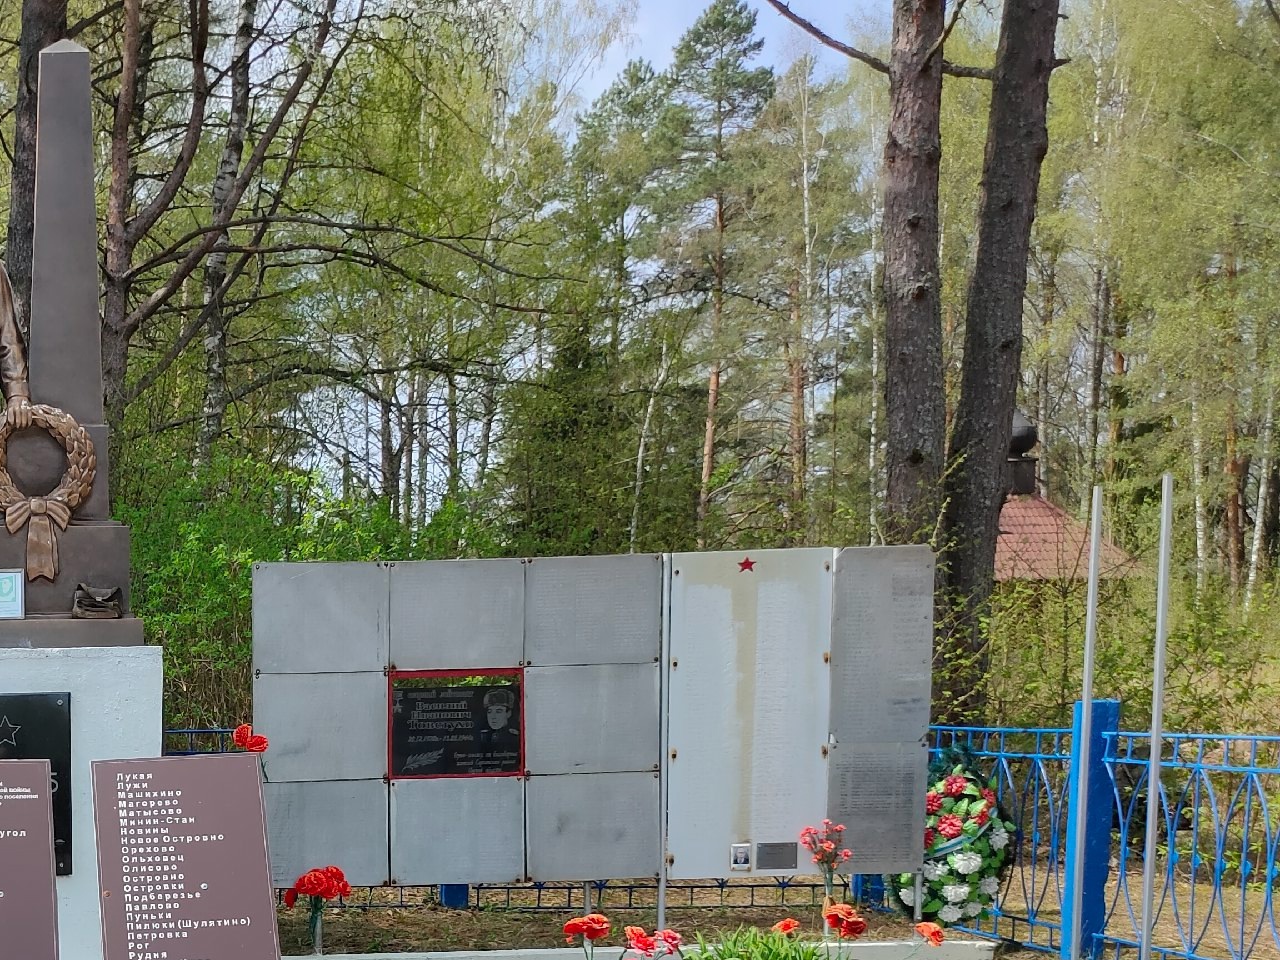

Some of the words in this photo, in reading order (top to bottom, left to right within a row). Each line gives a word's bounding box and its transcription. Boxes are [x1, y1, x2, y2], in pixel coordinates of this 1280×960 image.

[117, 773, 152, 782] Лукая
[117, 782, 148, 791] Лужи
[119, 809, 182, 817] Матысово
[120, 817, 194, 826] Минин-Стан
[163, 834, 224, 843] Островно
[122, 846, 174, 855] Орехово
[122, 855, 184, 863] Ольховец
[123, 864, 177, 872] Олисово
[123, 874, 184, 883] Островно
[124, 884, 184, 893] Островки
[126, 903, 179, 911] Павлово
[126, 913, 171, 922] Пуньки
[178, 917, 250, 929] (Шулятино)
[128, 932, 187, 941] Петровка
[129, 952, 167, 960] Рудня
